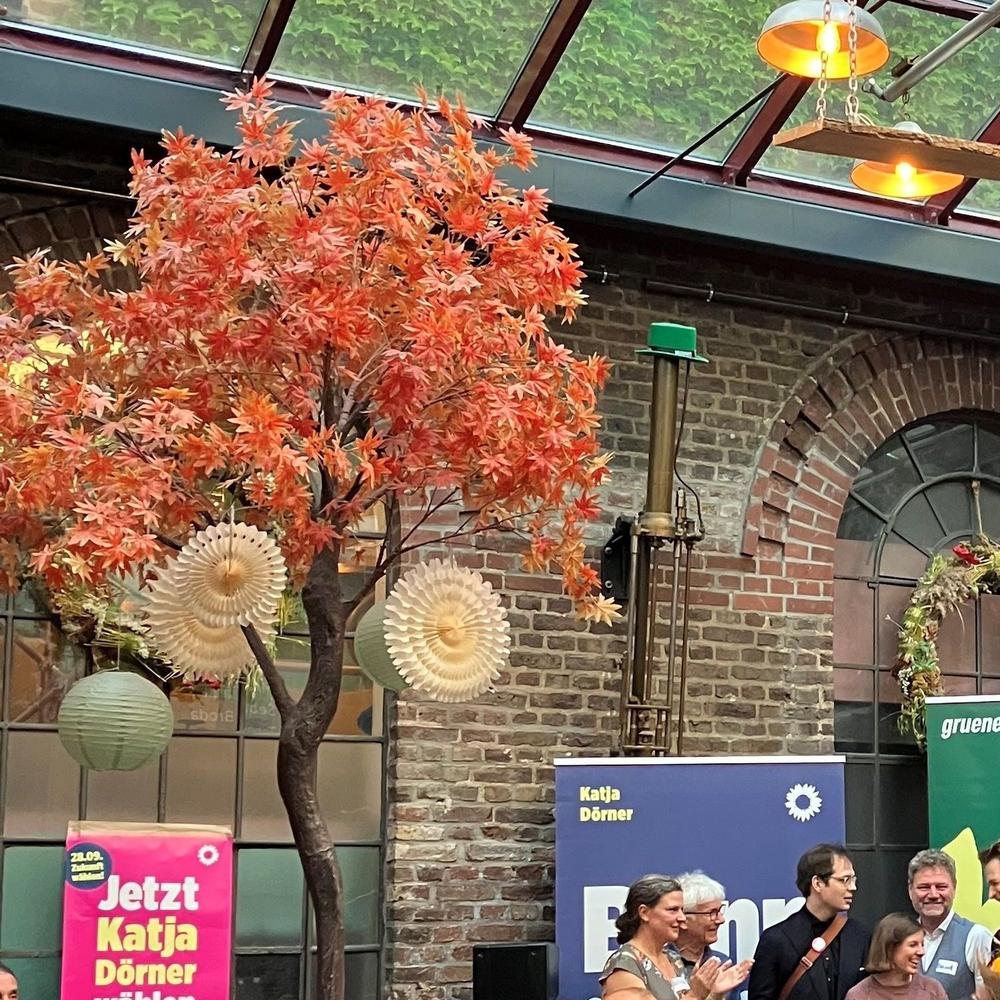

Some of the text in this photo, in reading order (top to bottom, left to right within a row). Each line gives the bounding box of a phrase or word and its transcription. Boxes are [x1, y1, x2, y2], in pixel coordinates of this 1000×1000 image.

[580, 786, 621, 803] Katja
[579, 807, 633, 822] Dörner
[70, 851, 104, 862] 28.09.
[98, 874, 199, 911] Jetzt
[97, 916, 198, 957] Katja
[95, 959, 197, 985] Dörner
